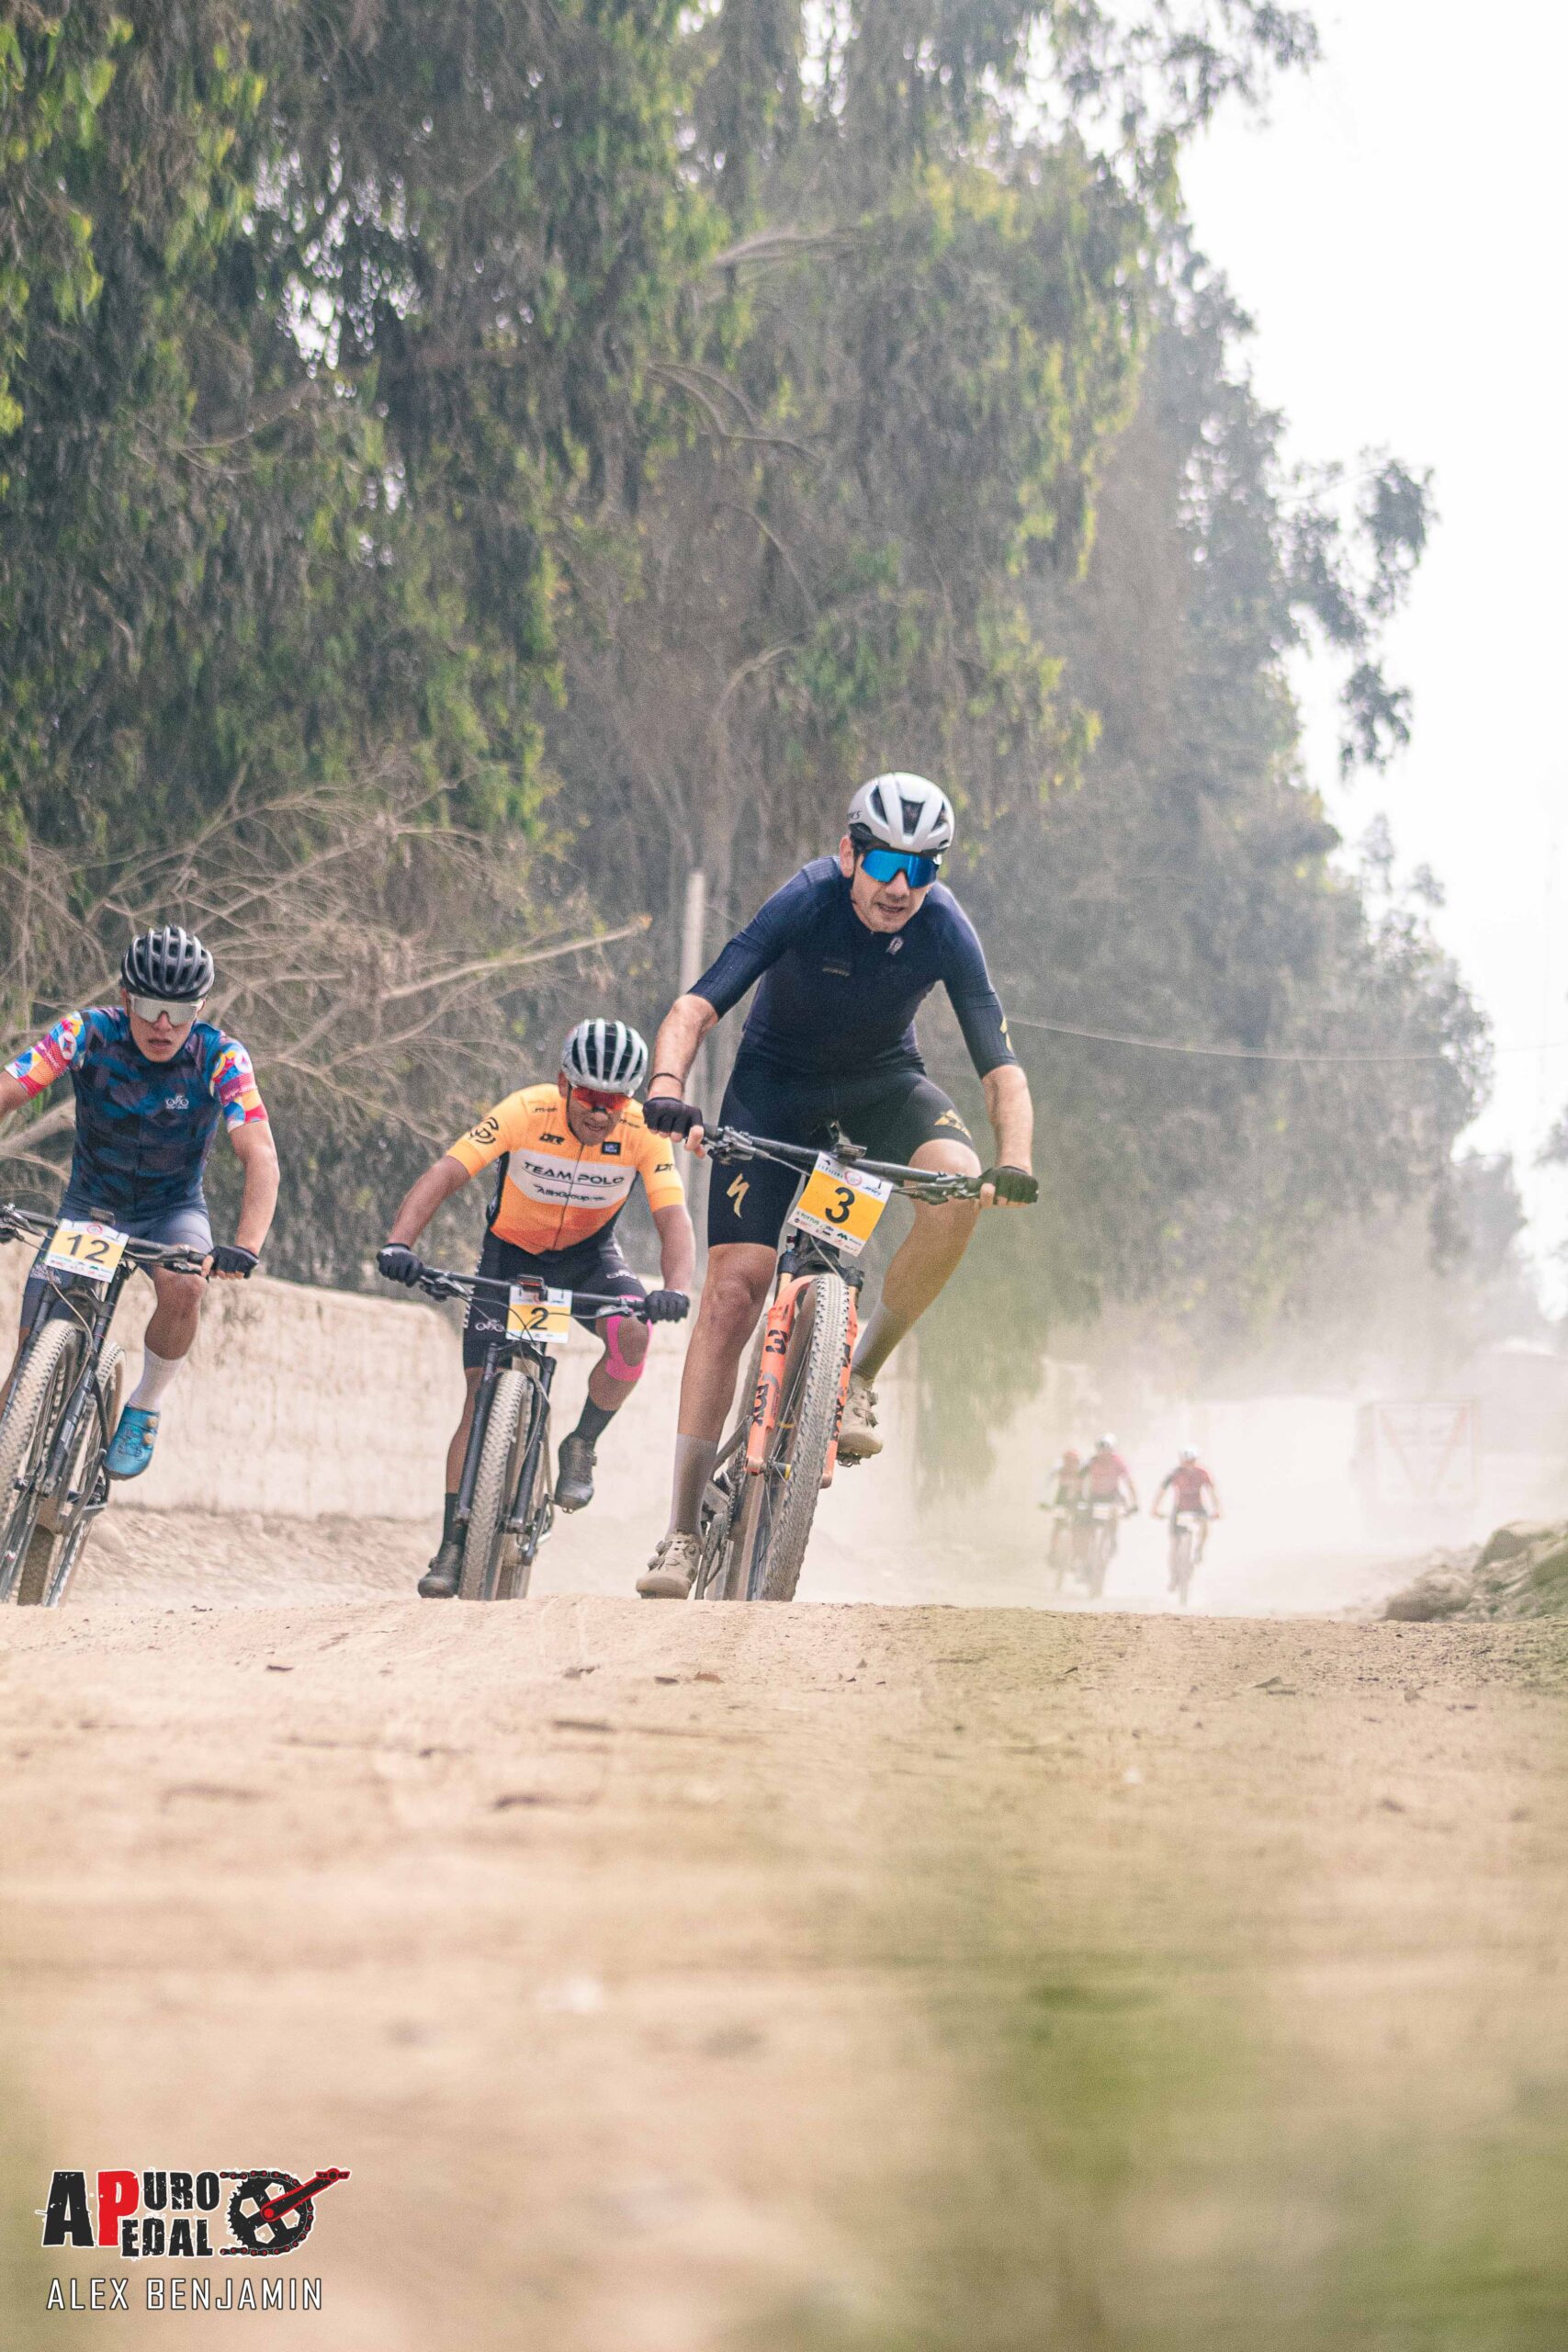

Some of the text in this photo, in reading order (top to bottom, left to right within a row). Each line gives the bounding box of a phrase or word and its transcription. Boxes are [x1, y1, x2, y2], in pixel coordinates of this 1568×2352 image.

[524, 1161, 625, 1185] TEAM POLO
[825, 1186, 855, 1224] 3
[67, 1234, 110, 1264] 12
[529, 1306, 549, 1330] 2
